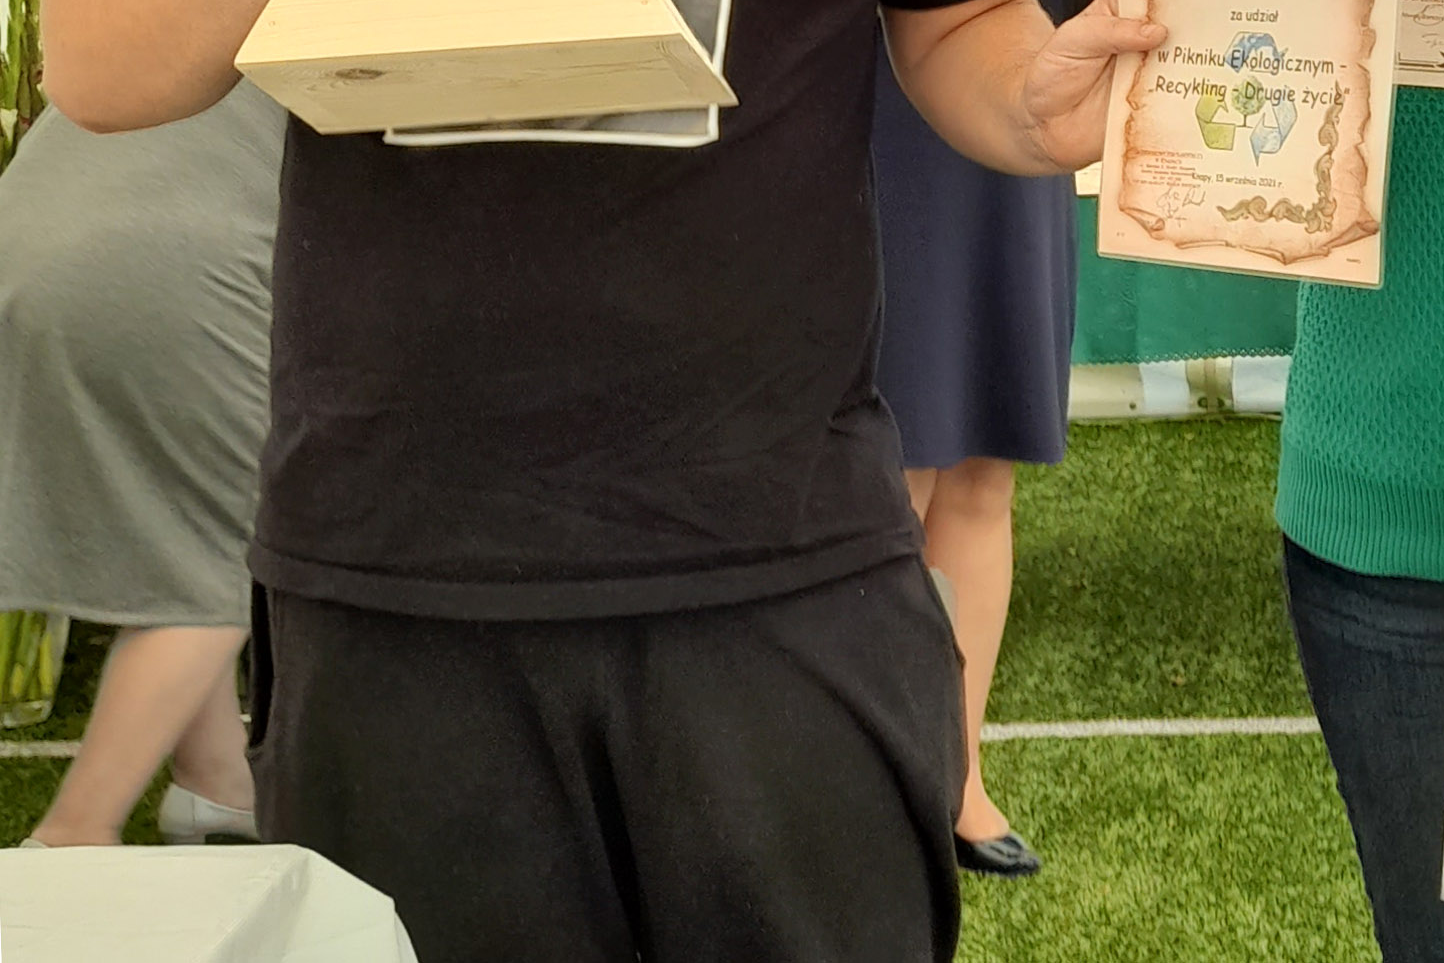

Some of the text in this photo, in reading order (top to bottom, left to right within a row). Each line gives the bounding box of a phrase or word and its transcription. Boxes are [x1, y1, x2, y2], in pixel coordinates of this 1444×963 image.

[1230, 9, 1278, 23] za udział
[1158, 52, 1169, 63] w
[1173, 47, 1226, 67] Pikniku
[1230, 49, 1334, 76] Ekologicznym
[1245, 82, 1296, 106] Drugie
